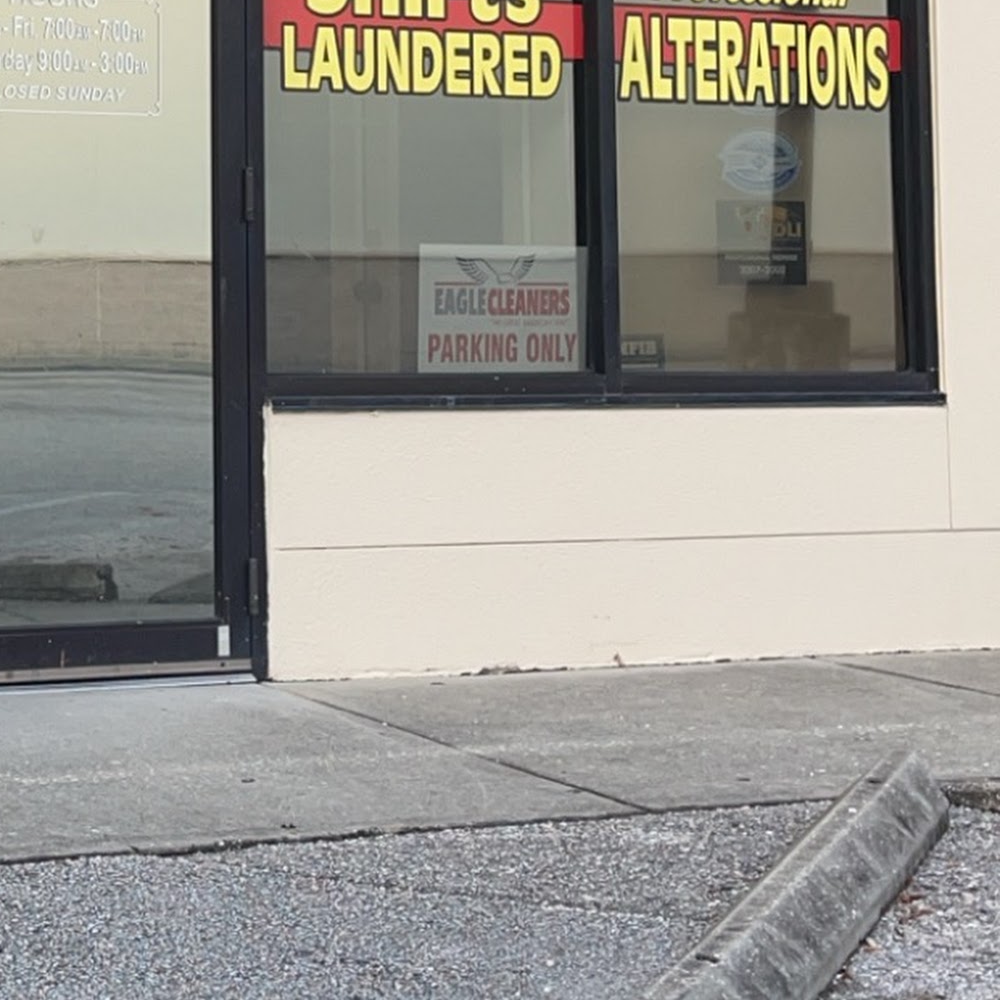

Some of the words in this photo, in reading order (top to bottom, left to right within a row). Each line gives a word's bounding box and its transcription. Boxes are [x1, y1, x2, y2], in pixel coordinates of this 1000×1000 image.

[281, 22, 564, 100] LAUNDERED
[618, 13, 891, 111] ALTERATIONS
[55, 86, 126, 102] SUNDAY
[434, 288, 487, 316] EAGLE
[487, 288, 570, 316] CLEANERS
[428, 333, 518, 363] PARKING
[526, 332, 577, 363] ONLY
